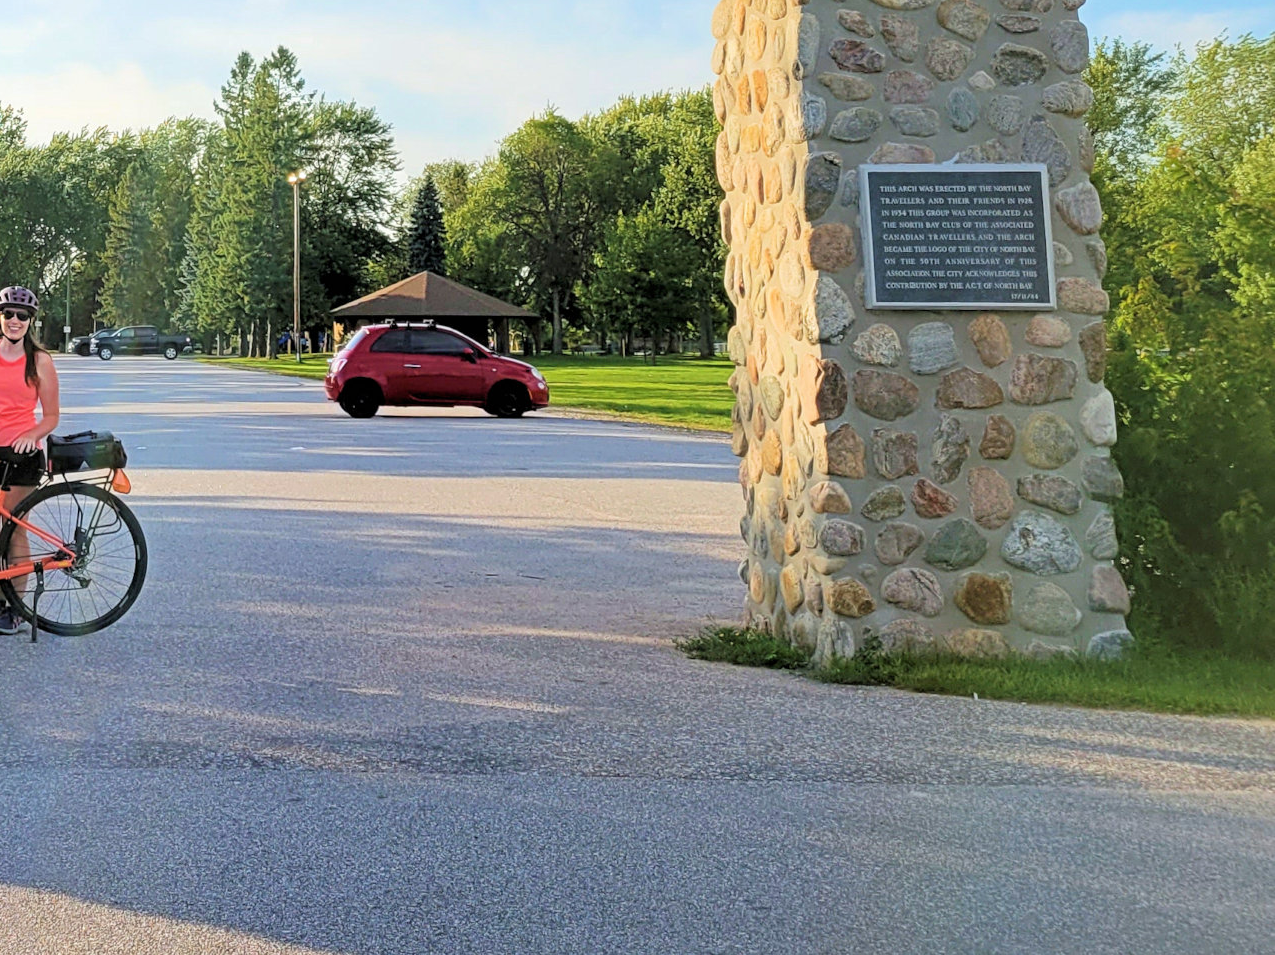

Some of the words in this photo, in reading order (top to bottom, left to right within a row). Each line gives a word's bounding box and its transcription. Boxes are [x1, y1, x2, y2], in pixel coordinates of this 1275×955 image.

[880, 185, 897, 193] THIS
[898, 185, 917, 193] ARCH
[919, 185, 934, 193] WAS
[935, 185, 966, 193] ERECTED
[880, 197, 925, 205] TRAVELLERS
[928, 197, 944, 205] AND
[947, 197, 970, 205] THEIR
[973, 197, 1005, 205] FRIENDS
[908, 209, 924, 217] THIS
[926, 209, 949, 217] GROUP
[951, 209, 966, 217] WAS
[968, 209, 1021, 217] INCORPORATED
[1023, 209, 1033, 217] AS
[882, 221, 897, 229] THE
[899, 221, 924, 229] NORTH
[925, 221, 940, 229] BAY
[941, 221, 961, 229] CLUB
[962, 221, 972, 229] OF
[974, 221, 989, 229] THE
[990, 221, 1034, 229] ASSOCIATED
[883, 233, 925, 241] CANADIAN
[928, 233, 976, 241] TRAVELLERS
[977, 233, 994, 241] AND
[997, 233, 1012, 241] THE
[1014, 233, 1035, 241] ARCH
[884, 245, 913, 253] BECAME
[913, 245, 928, 253] THE
[928, 245, 947, 253] LOGO
[958, 245, 973, 253] THE
[973, 245, 989, 253] CITY
[999, 245, 1023, 253] NORTH
[945, 257, 1000, 265] ANNIVERSARY
[1005, 257, 1015, 265] OF
[1020, 257, 1037, 265] THIS
[1022, 270, 1037, 278] THIS
[938, 282, 948, 290] BY
[950, 282, 964, 290] THE
[994, 282, 1018, 290] NORTH
